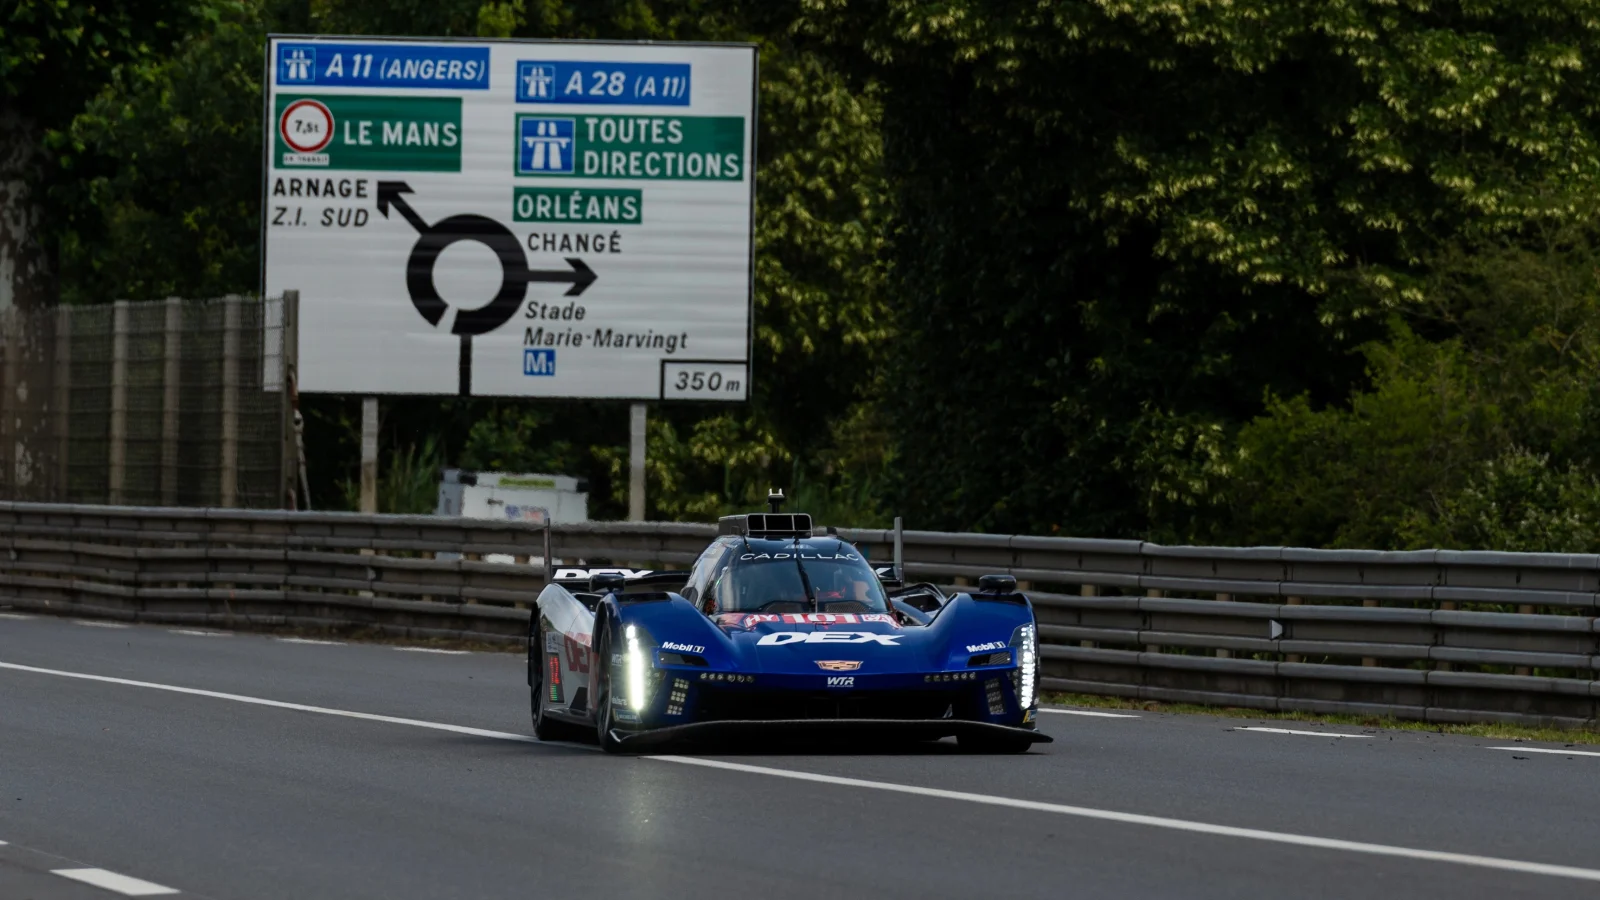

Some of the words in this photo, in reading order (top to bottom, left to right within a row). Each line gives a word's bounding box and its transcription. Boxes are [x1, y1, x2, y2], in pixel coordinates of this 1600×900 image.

[325, 53, 344, 77] A
[352, 54, 373, 78] 11
[380, 58, 485, 82] (ANGERS)
[564, 71, 583, 95] A
[589, 71, 626, 96] 28
[634, 76, 656, 98] (A
[662, 76, 686, 98] 11)
[344, 120, 373, 145] LE
[382, 121, 458, 147] MANS
[585, 117, 683, 144] TOUTES
[584, 150, 740, 178] DIRECTIONS
[273, 178, 368, 198] ARNAGE
[517, 190, 637, 221] ORLÉANS
[272, 207, 307, 226] Z.I.
[321, 208, 369, 227] SUD
[528, 230, 622, 253] CHANGÉ
[525, 301, 586, 321] Stade
[523, 327, 688, 354] Marie-Marvingt
[675, 371, 722, 391] 350
[725, 379, 740, 392] m
[740, 552, 859, 561] CADILLAC
[662, 641, 693, 652] Mobil
[756, 631, 905, 646] DEX
[966, 642, 996, 653] Mobil
[827, 676, 855, 685] WTR
